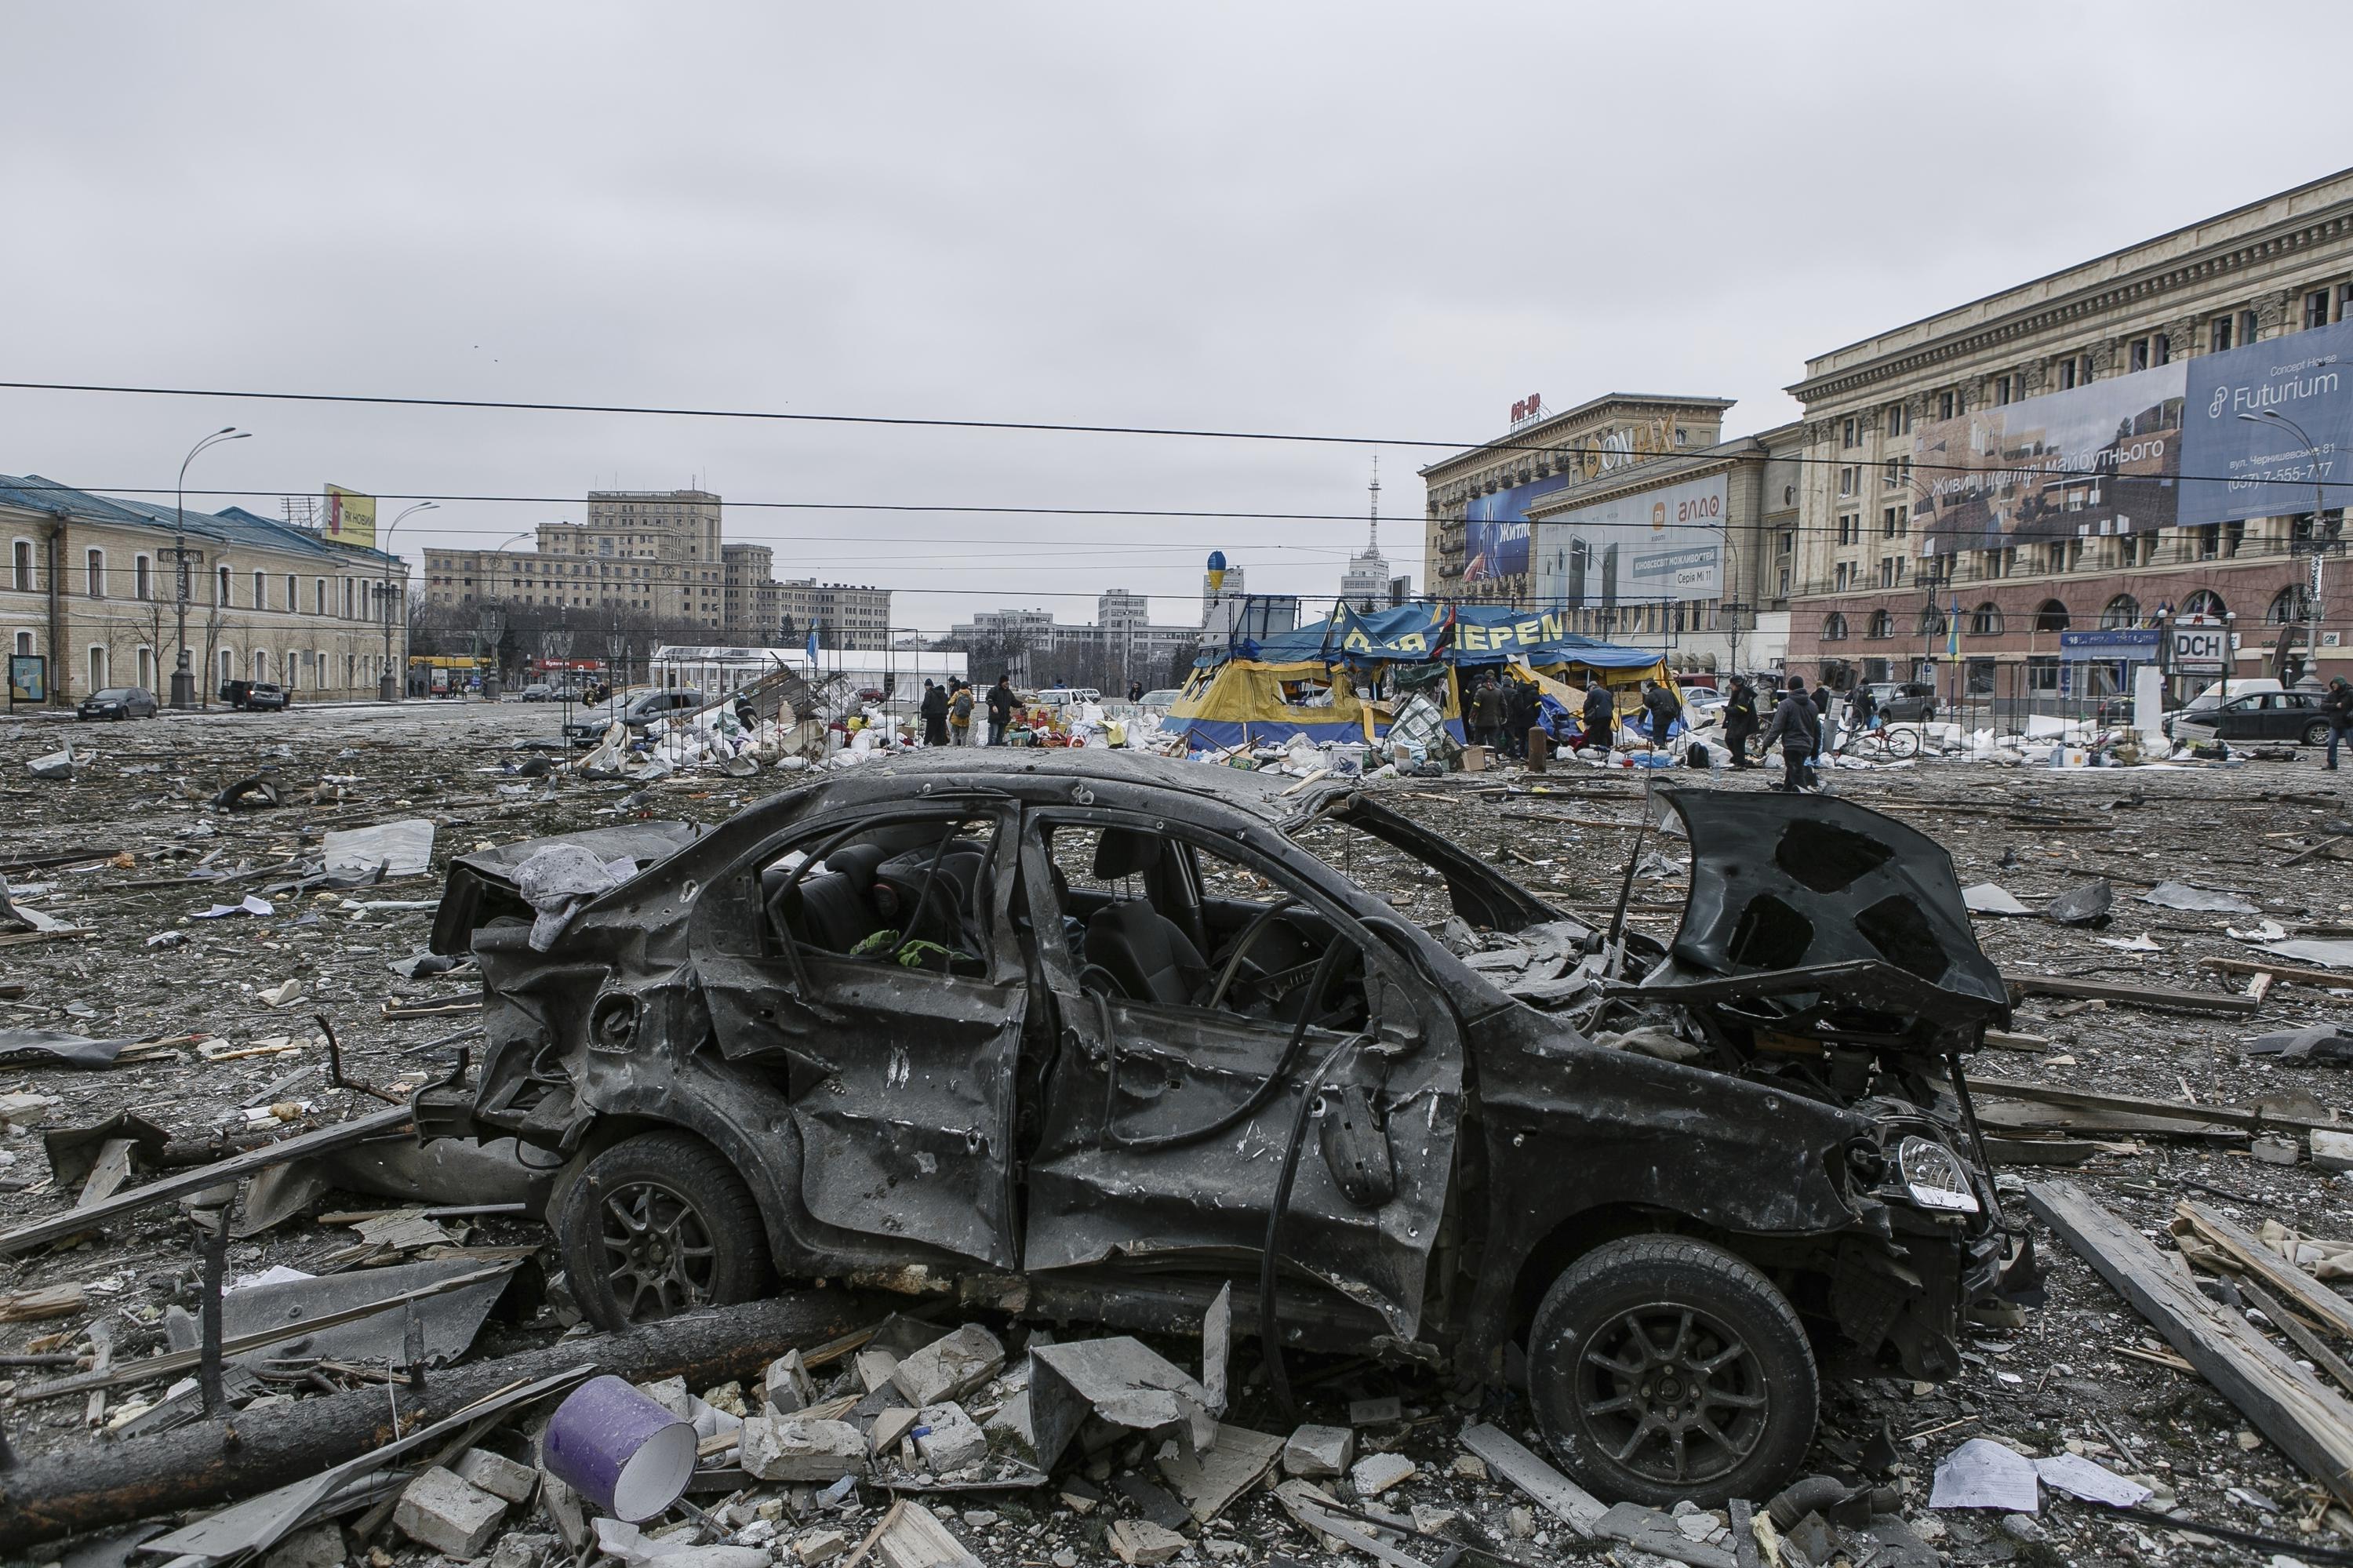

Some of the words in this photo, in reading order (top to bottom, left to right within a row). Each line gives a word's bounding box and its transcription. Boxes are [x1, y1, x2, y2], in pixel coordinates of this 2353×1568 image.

[2271, 360, 2305, 377] Concept
[2234, 373, 2339, 411] Futurium
[2229, 459, 2248, 470] вул.
[2322, 442, 2335, 454] 81
[1932, 475, 1969, 497] Живи
[2045, 439, 2165, 475] майбутнього
[2228, 472, 2260, 493] (057)
[352, 512, 374, 527] НОВИЙ
[1635, 558, 1669, 571] КІНОВСЕСВІТ
[1669, 549, 1715, 566] МОЖЛИВОСТЕЙ
[1678, 573, 1695, 585] Серія
[1697, 571, 1704, 581] Mi
[1706, 570, 1711, 580] 11
[1344, 627, 1427, 653] ДЯ
[2177, 635, 2220, 657] DCH
